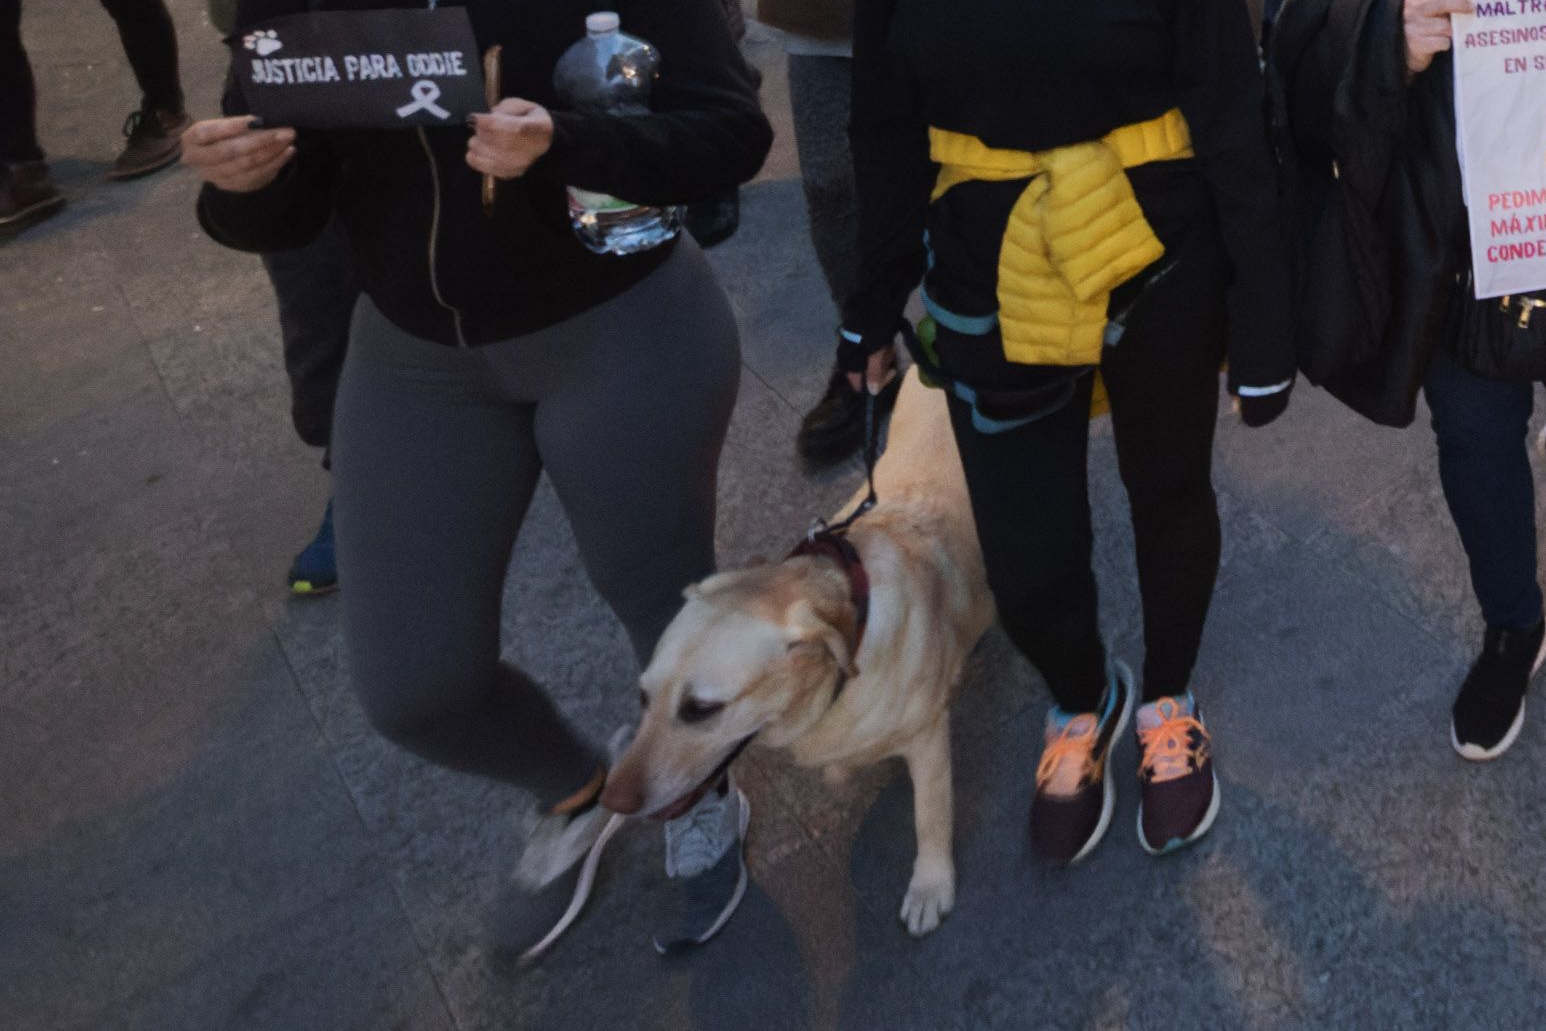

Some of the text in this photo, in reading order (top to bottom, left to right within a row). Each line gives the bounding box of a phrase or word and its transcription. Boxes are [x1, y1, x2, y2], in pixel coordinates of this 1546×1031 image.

[252, 55, 341, 85] JUSTICIA
[343, 52, 403, 81] PARA
[1504, 55, 1527, 75] EN
